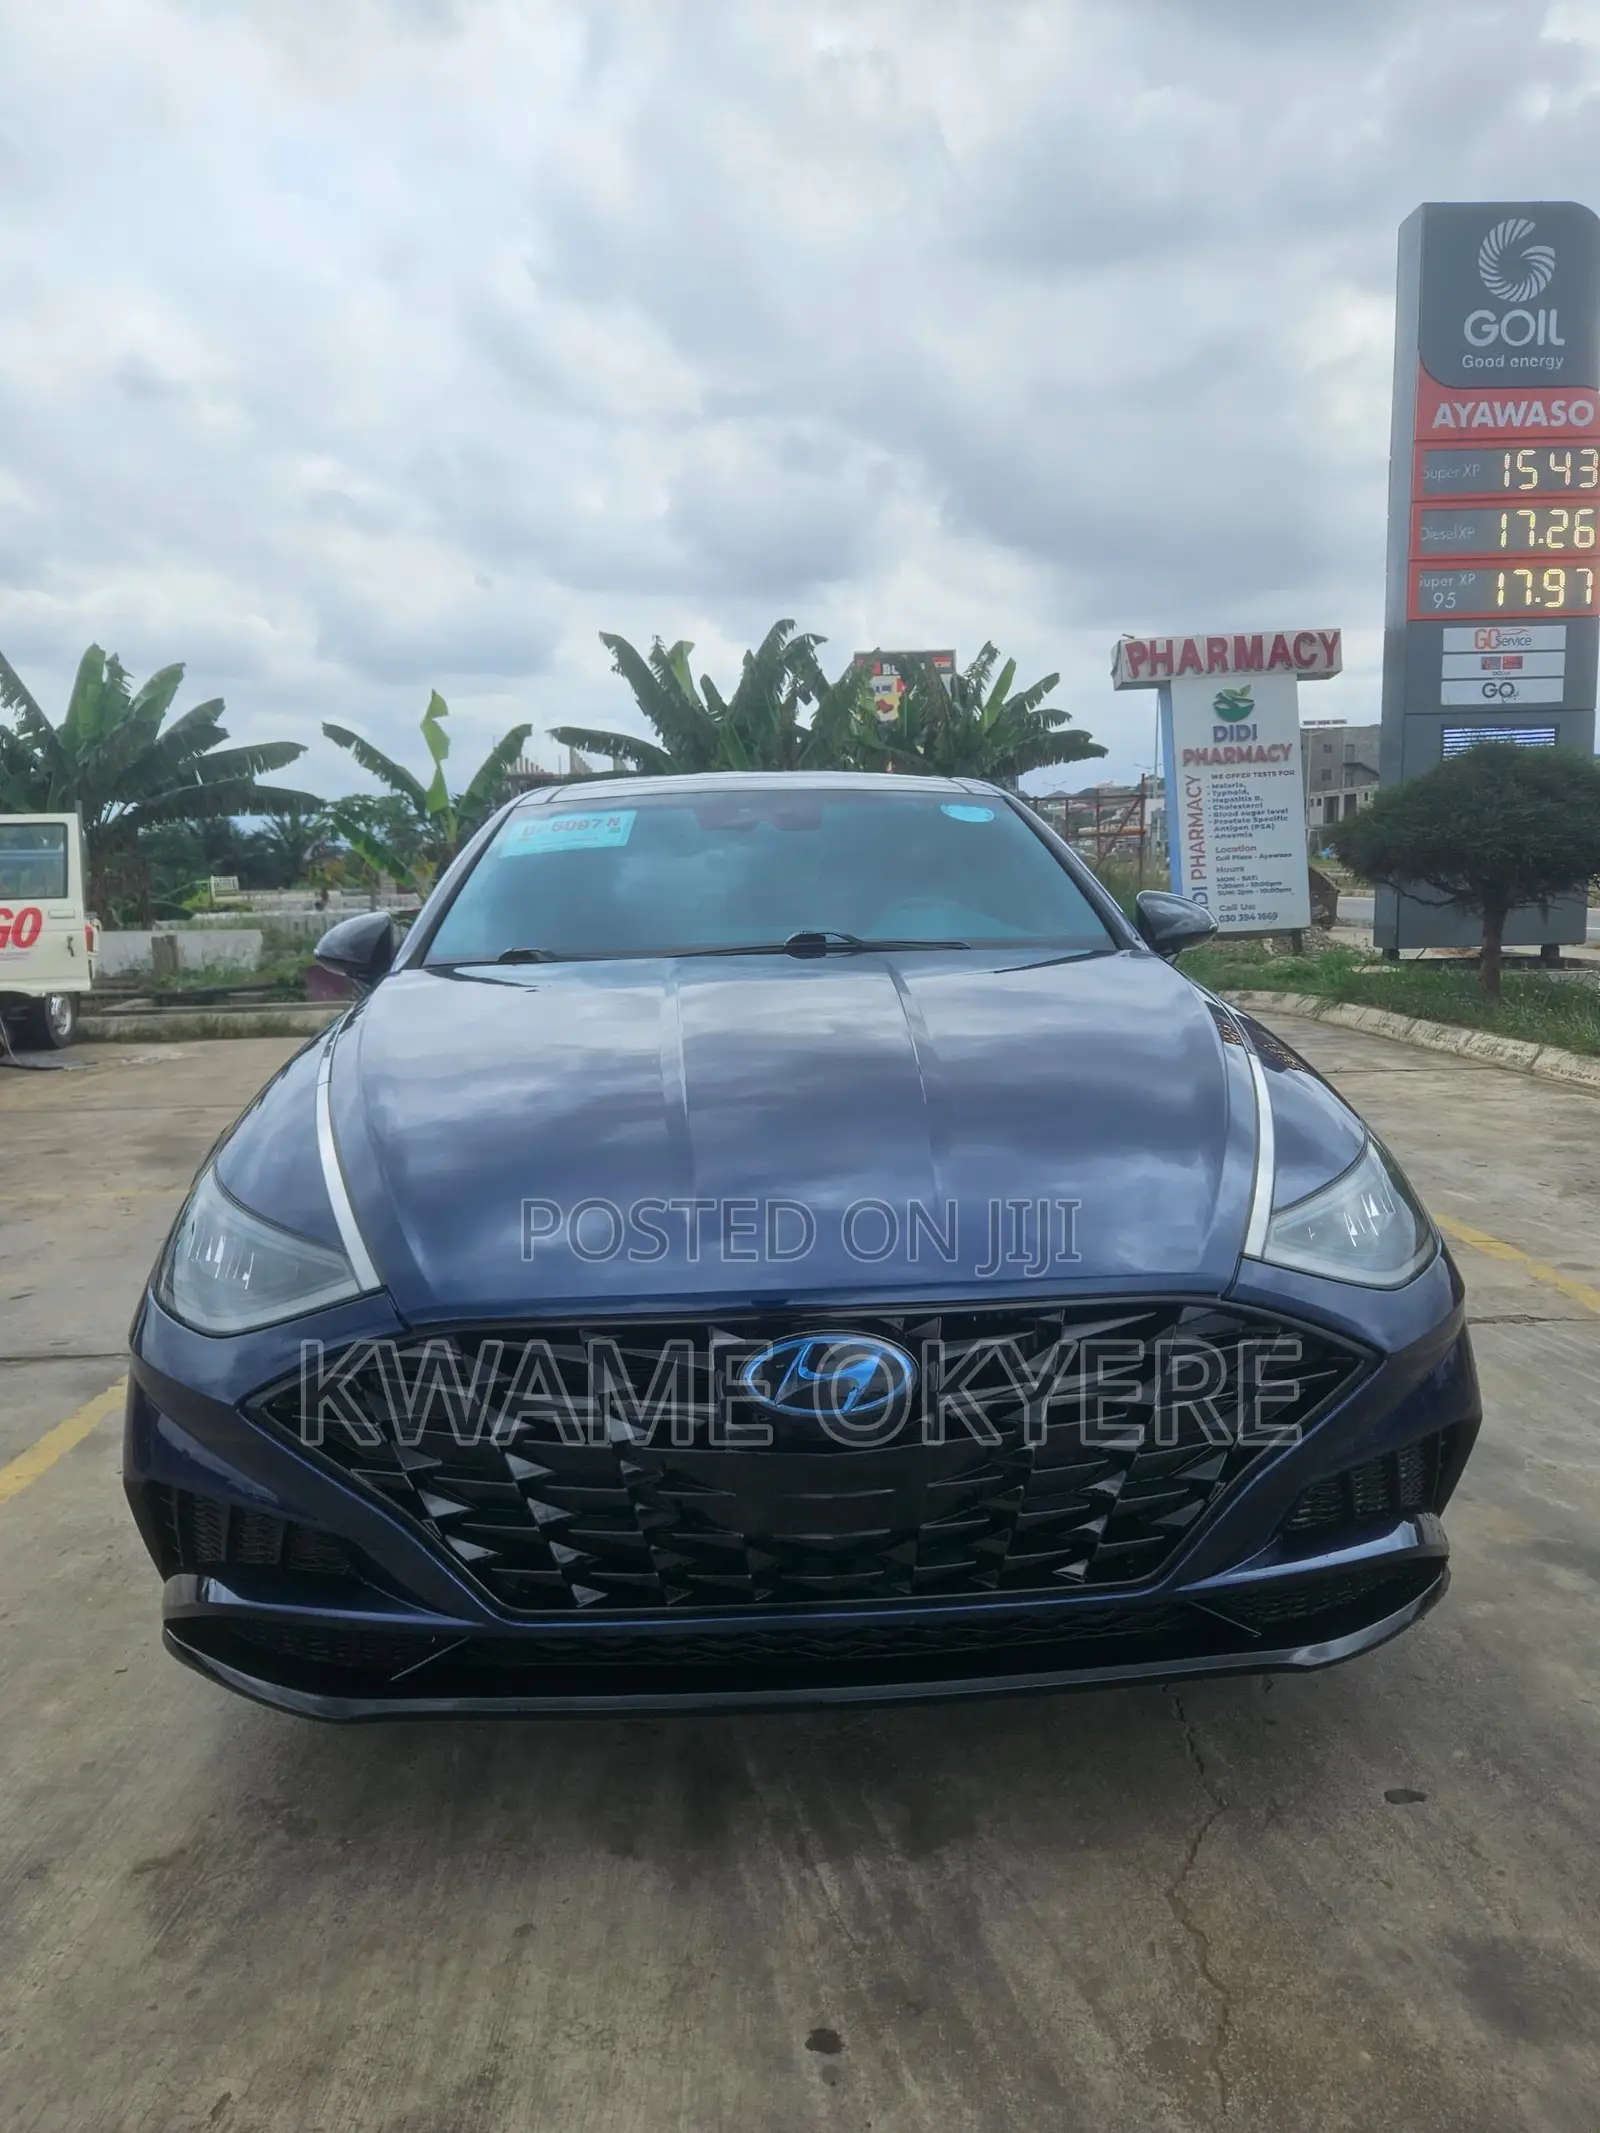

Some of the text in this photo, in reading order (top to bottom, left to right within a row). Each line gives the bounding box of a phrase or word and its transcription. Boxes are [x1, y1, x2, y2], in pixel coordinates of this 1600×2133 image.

[1463, 309, 1565, 347] GOIL
[1462, 355, 1564, 371] Good energy
[1431, 400, 1595, 429] AYAWASO
[1422, 464, 1481, 482] Super XP
[1501, 508, 1595, 549] 17.26
[1459, 572, 1476, 586] XP
[1497, 568, 1594, 608] 17.97
[1433, 592, 1457, 609] 95
[1124, 632, 1341, 679] PHARMACY
[1212, 724, 1258, 743] DIDI
[1182, 744, 1293, 767] PHARMACY
[1278, 769, 1295, 777] FOR
[1185, 774, 1208, 881] PHARMACY
[1215, 844, 1257, 854] Location
